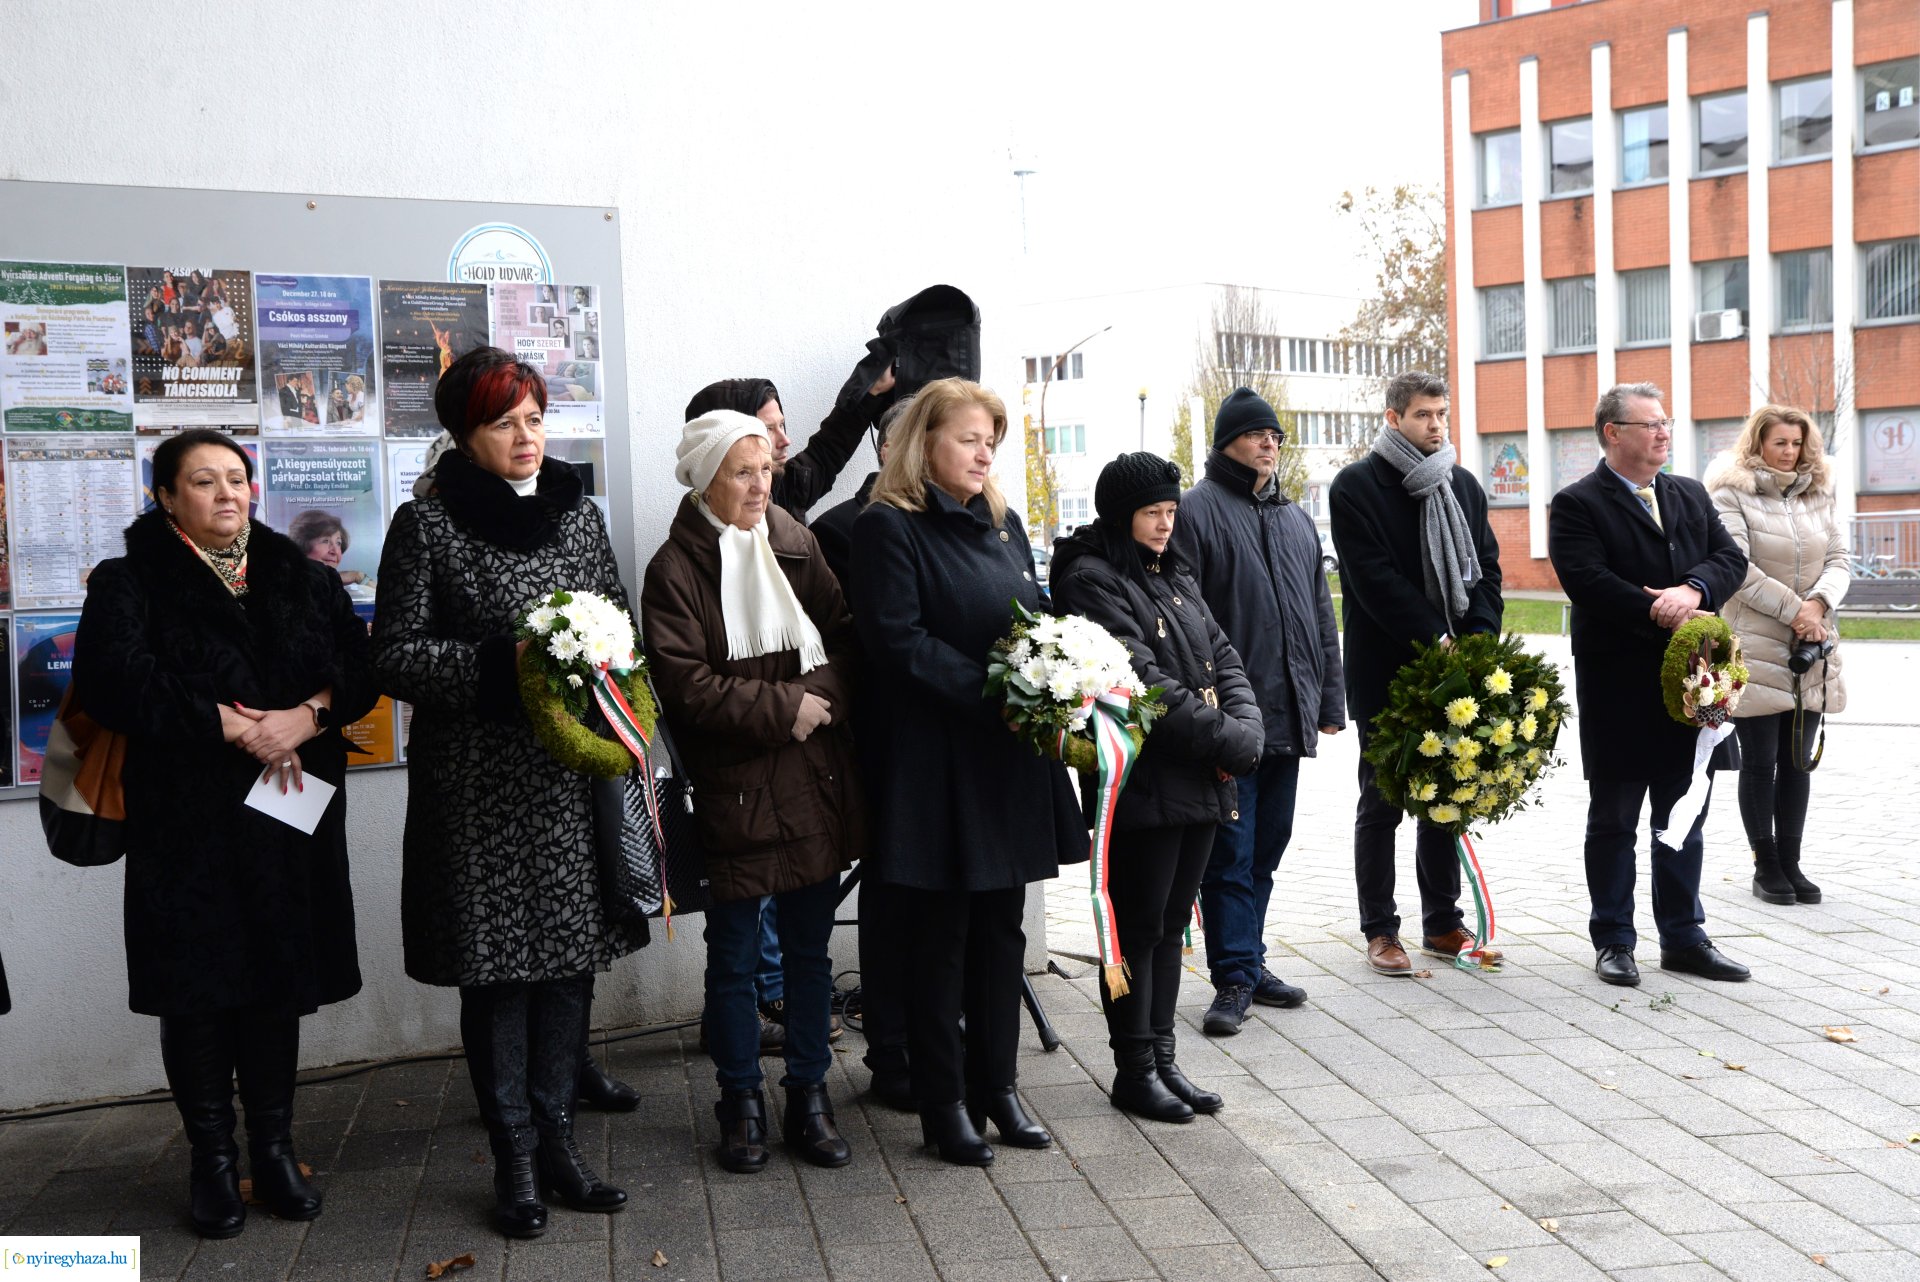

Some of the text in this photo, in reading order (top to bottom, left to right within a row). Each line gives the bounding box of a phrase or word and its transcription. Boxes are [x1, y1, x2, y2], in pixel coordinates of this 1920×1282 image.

[39, 271, 64, 281] Adventi
[65, 272, 94, 284] Forgatag
[95, 273, 103, 282] és
[104, 273, 123, 283] Vásár
[467, 266, 534, 281] HOLD UDVAR
[269, 310, 348, 326] Csókos asszony
[517, 339, 561, 348] HOGY SZERET
[523, 350, 545, 360] MÁSIK
[162, 367, 243, 381] NO COMMENT
[164, 382, 239, 397] TÁNCISKOLA
[328, 445, 348, 453] február
[285, 458, 367, 472] kiegyensúlyozott
[271, 471, 335, 485] párkapcsolat
[1493, 482, 1529, 494] TRIUM
[47, 661, 73, 670] LEM
